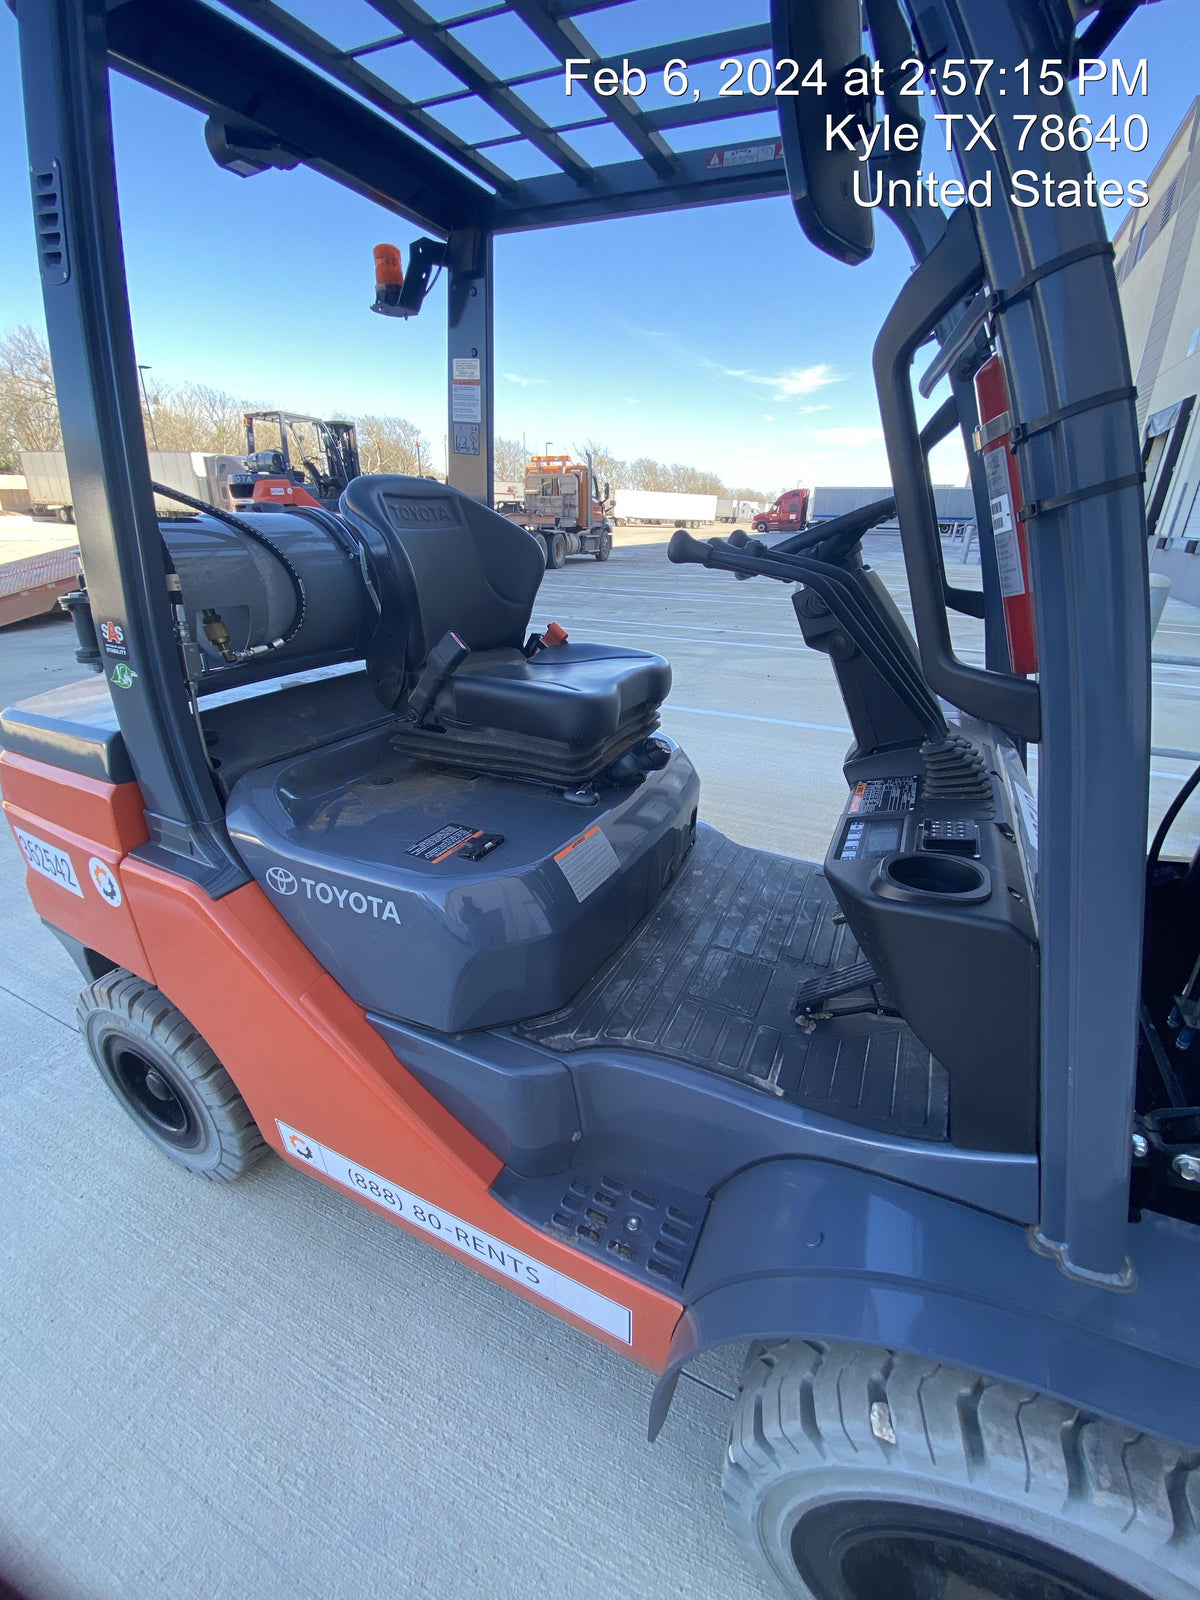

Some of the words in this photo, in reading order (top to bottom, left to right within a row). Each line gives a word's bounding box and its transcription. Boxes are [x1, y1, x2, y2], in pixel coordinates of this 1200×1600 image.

[389, 503, 452, 521] TOYOTA
[101, 621, 124, 643] SAS
[18, 835, 77, 888] 362542
[300, 877, 402, 925] TOYOTA
[348, 1168, 403, 1211] (888)
[412, 1204, 541, 1285] 80-RENTS
